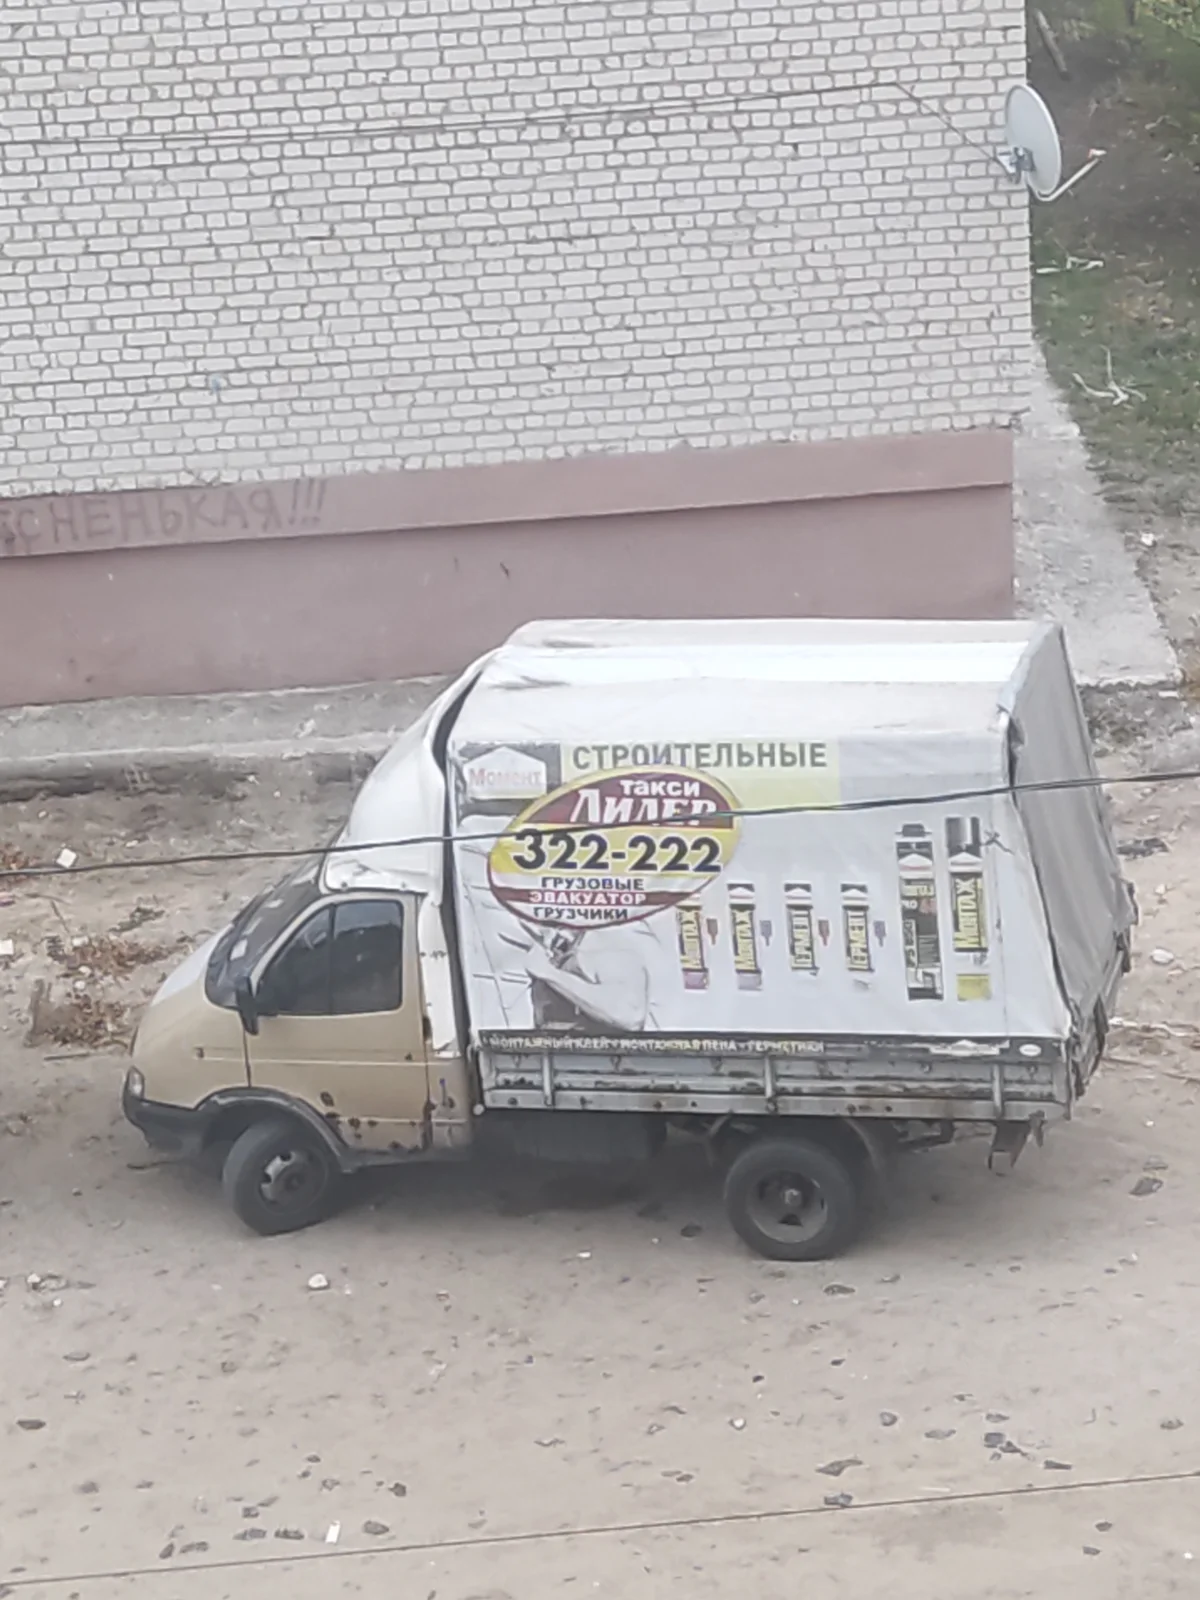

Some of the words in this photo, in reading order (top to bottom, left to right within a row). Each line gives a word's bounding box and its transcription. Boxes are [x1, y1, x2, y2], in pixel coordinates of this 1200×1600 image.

[573, 742, 827, 769] СТРОИТЕЛЬНЫЕ
[512, 828, 722, 873] 322-222
[541, 876, 645, 891] ГРУЗОВЫЕ
[529, 890, 647, 906] ЭВАКУАТОР
[533, 906, 629, 921] ГРУЗЧИКИ
